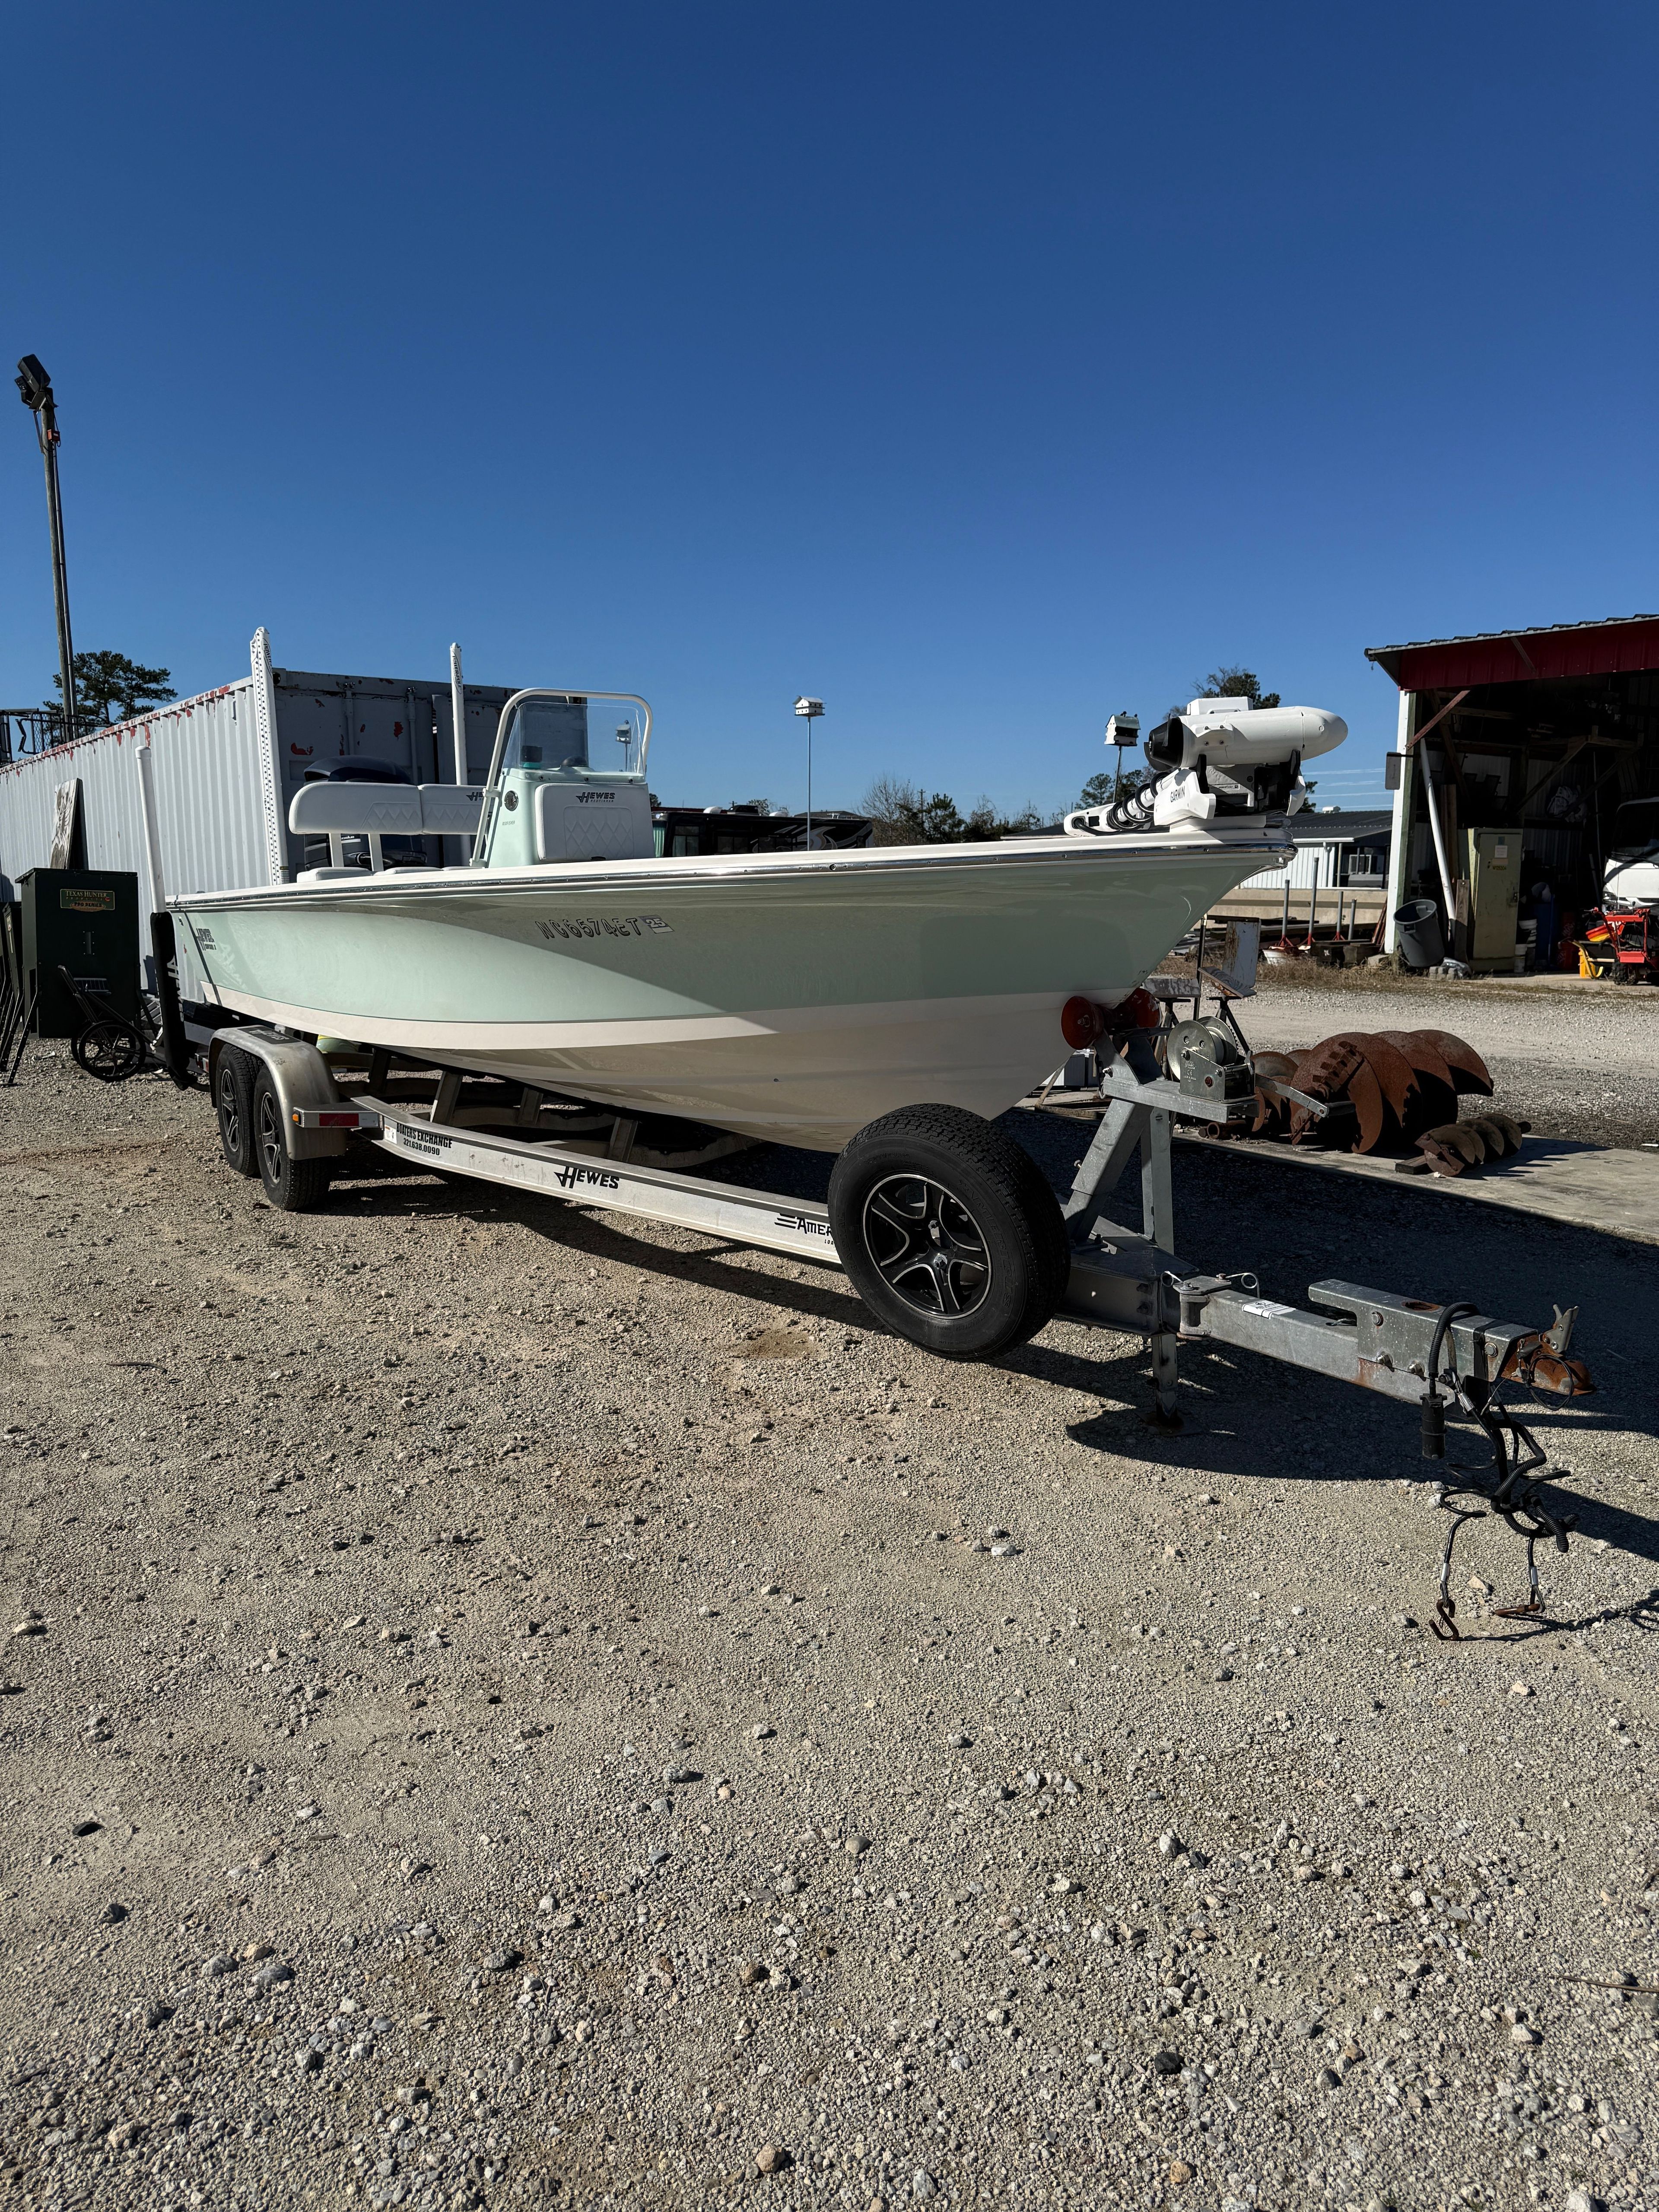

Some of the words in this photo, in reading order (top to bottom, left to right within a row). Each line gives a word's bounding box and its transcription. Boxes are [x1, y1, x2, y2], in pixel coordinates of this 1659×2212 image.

[575, 792, 615, 803] HEWES
[1170, 785, 1185, 803] GARMIN
[645, 918, 666, 928] 25
[397, 1122, 416, 1140] BOATERS
[416, 1130, 453, 1149] EXCHANGE
[403, 1138, 440, 1156] 321.638.0090
[553, 1166, 620, 1189] HEWES
[797, 1217, 832, 1236] AMER
